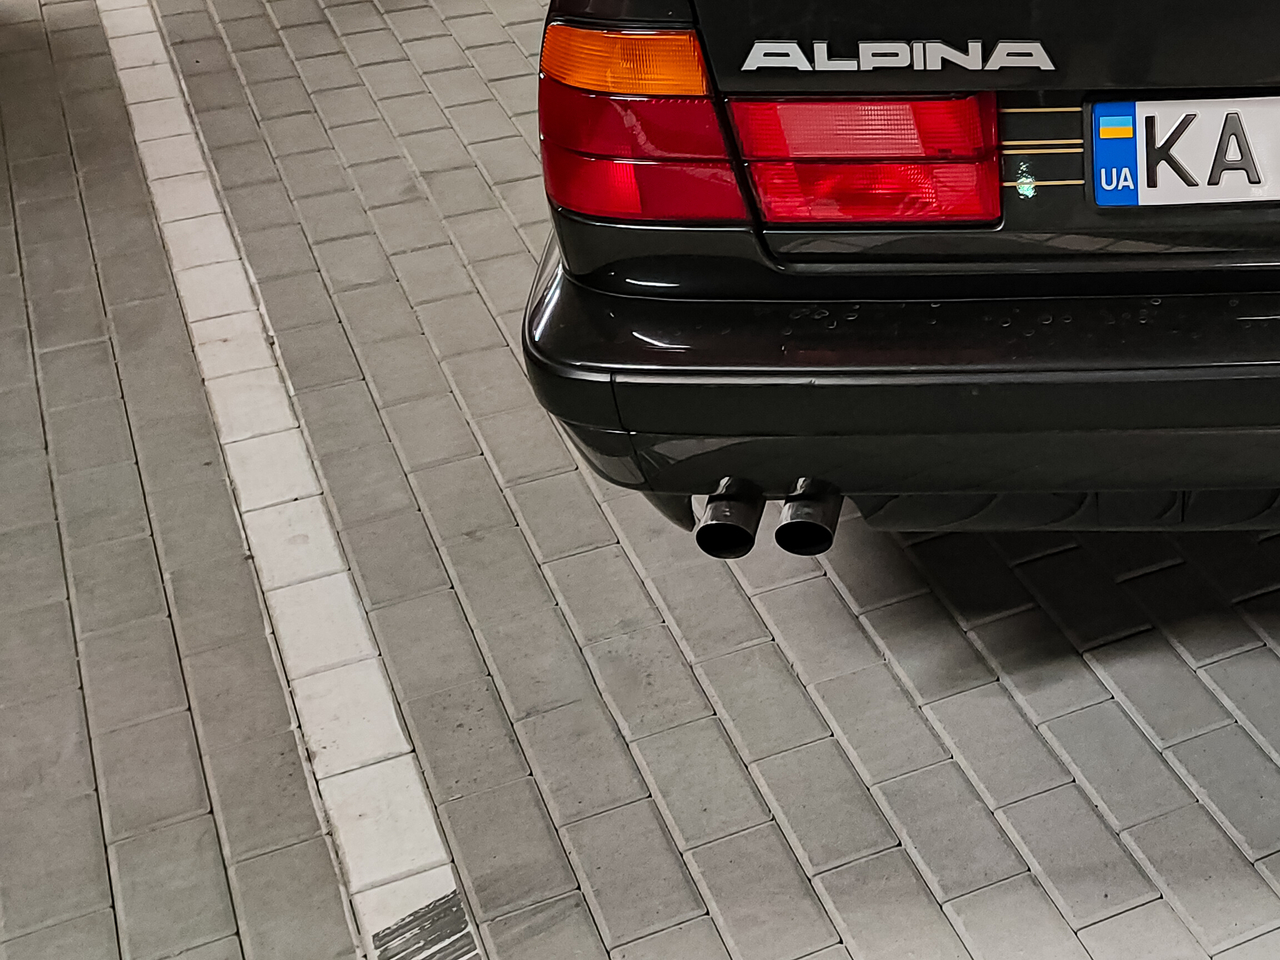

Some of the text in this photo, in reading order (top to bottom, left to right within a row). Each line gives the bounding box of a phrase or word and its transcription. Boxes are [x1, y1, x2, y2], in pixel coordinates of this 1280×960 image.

[741, 40, 1056, 71] ALPINA
[1101, 167, 1135, 191] UA
[1145, 112, 1261, 189] KA
